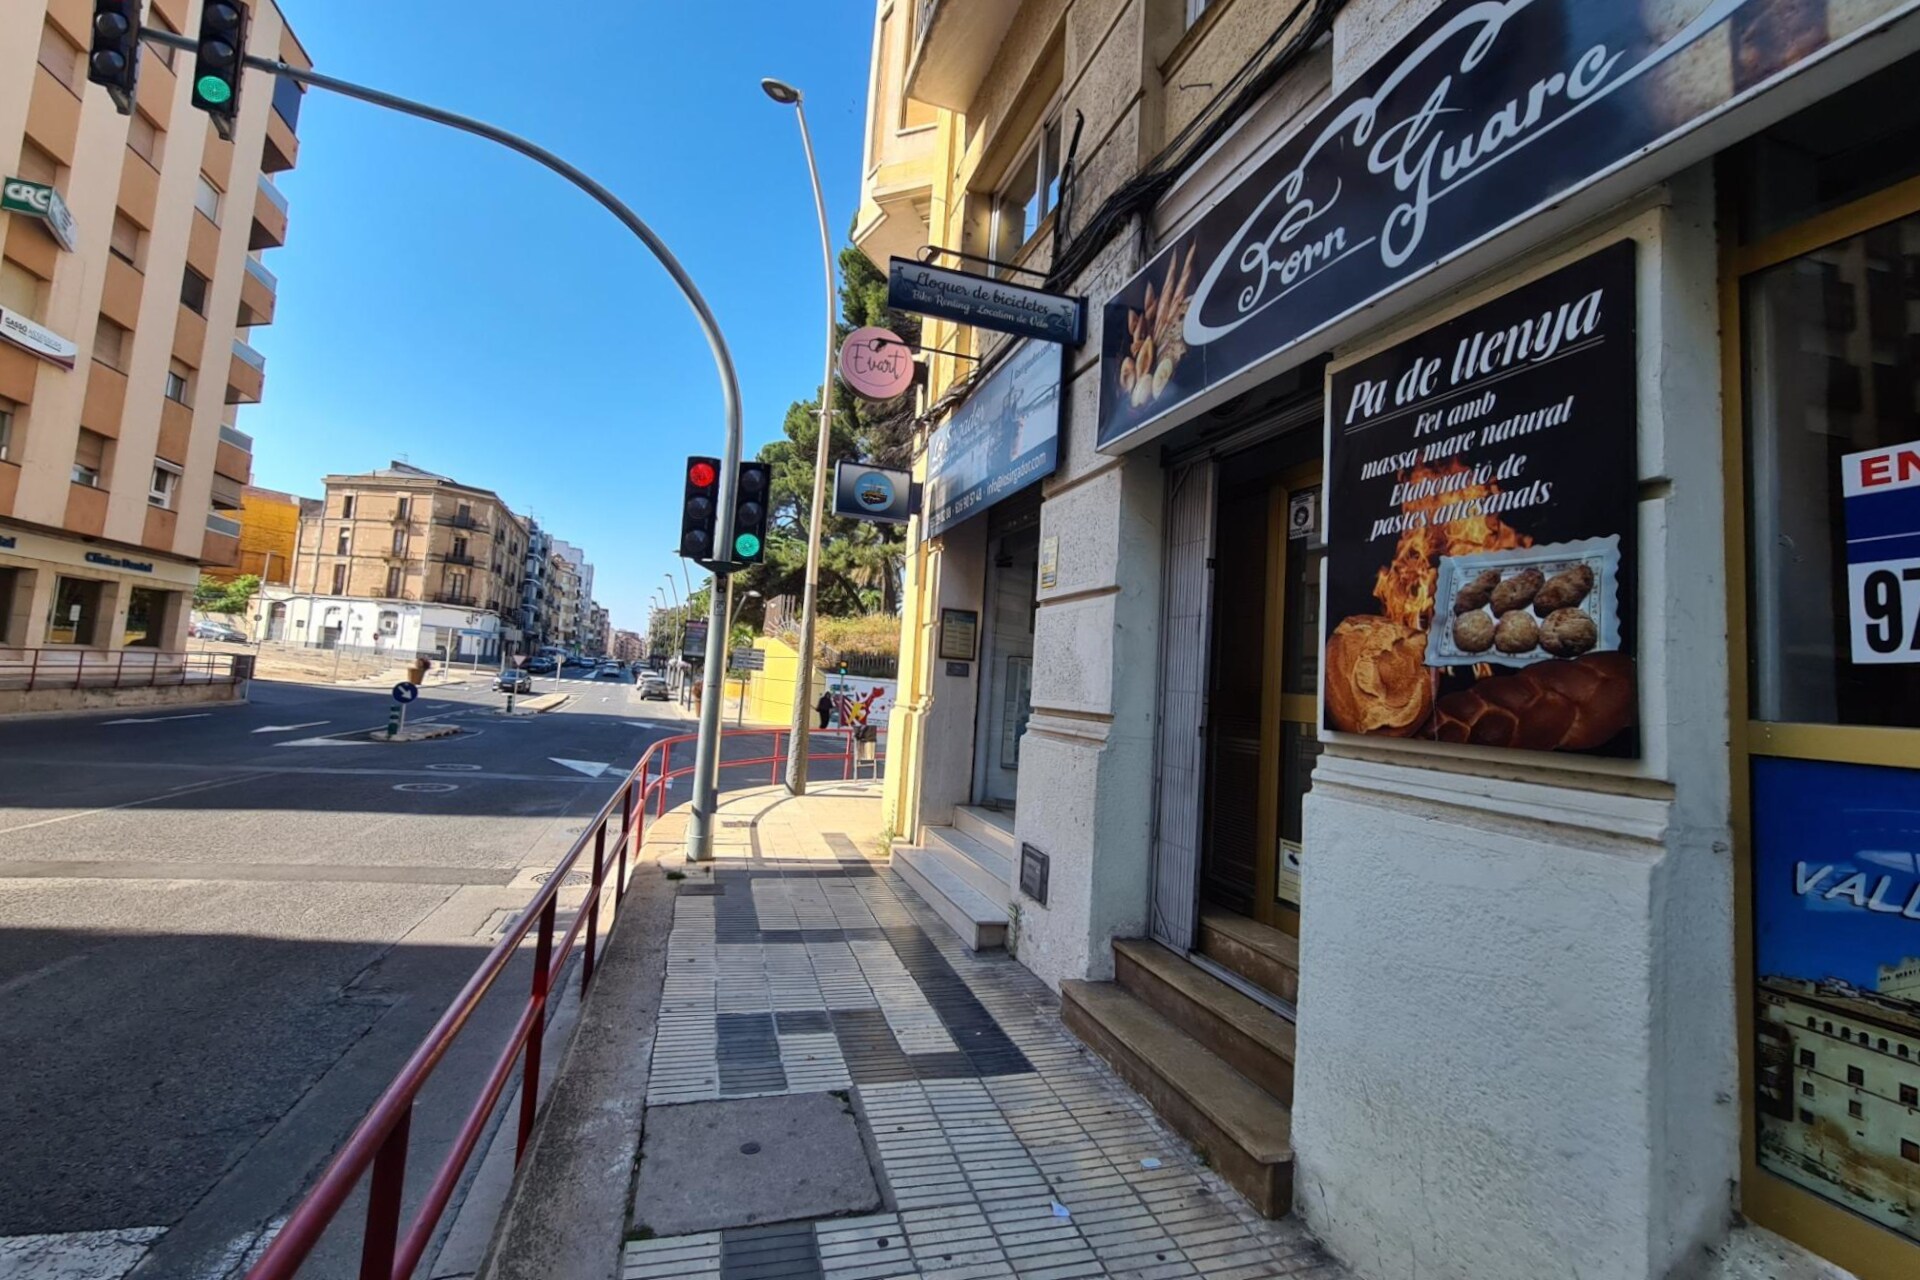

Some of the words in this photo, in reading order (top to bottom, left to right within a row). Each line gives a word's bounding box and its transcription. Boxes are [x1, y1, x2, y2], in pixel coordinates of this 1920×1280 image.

[5, 182, 51, 211] CRC
[1237, 177, 1347, 311] Forn
[1367, 41, 1628, 268] Guarc
[916, 271, 968, 296] Lloquer
[972, 285, 990, 303] de
[992, 292, 1050, 316] bicicletes
[850, 343, 905, 380] Evart
[1344, 379, 1389, 425] Pa
[1394, 357, 1443, 406] de
[1450, 288, 1604, 385] llenya
[1360, 447, 1419, 481] massa
[1422, 429, 1476, 463] mare
[1480, 395, 1575, 447] natural
[1413, 408, 1443, 438] Fet
[1446, 390, 1498, 427] amb
[1389, 459, 1494, 508] Elaboració
[1496, 453, 1528, 480] de
[1860, 450, 1920, 487] EN
[1369, 507, 1428, 542] pastes
[1432, 480, 1554, 526] artesanals
